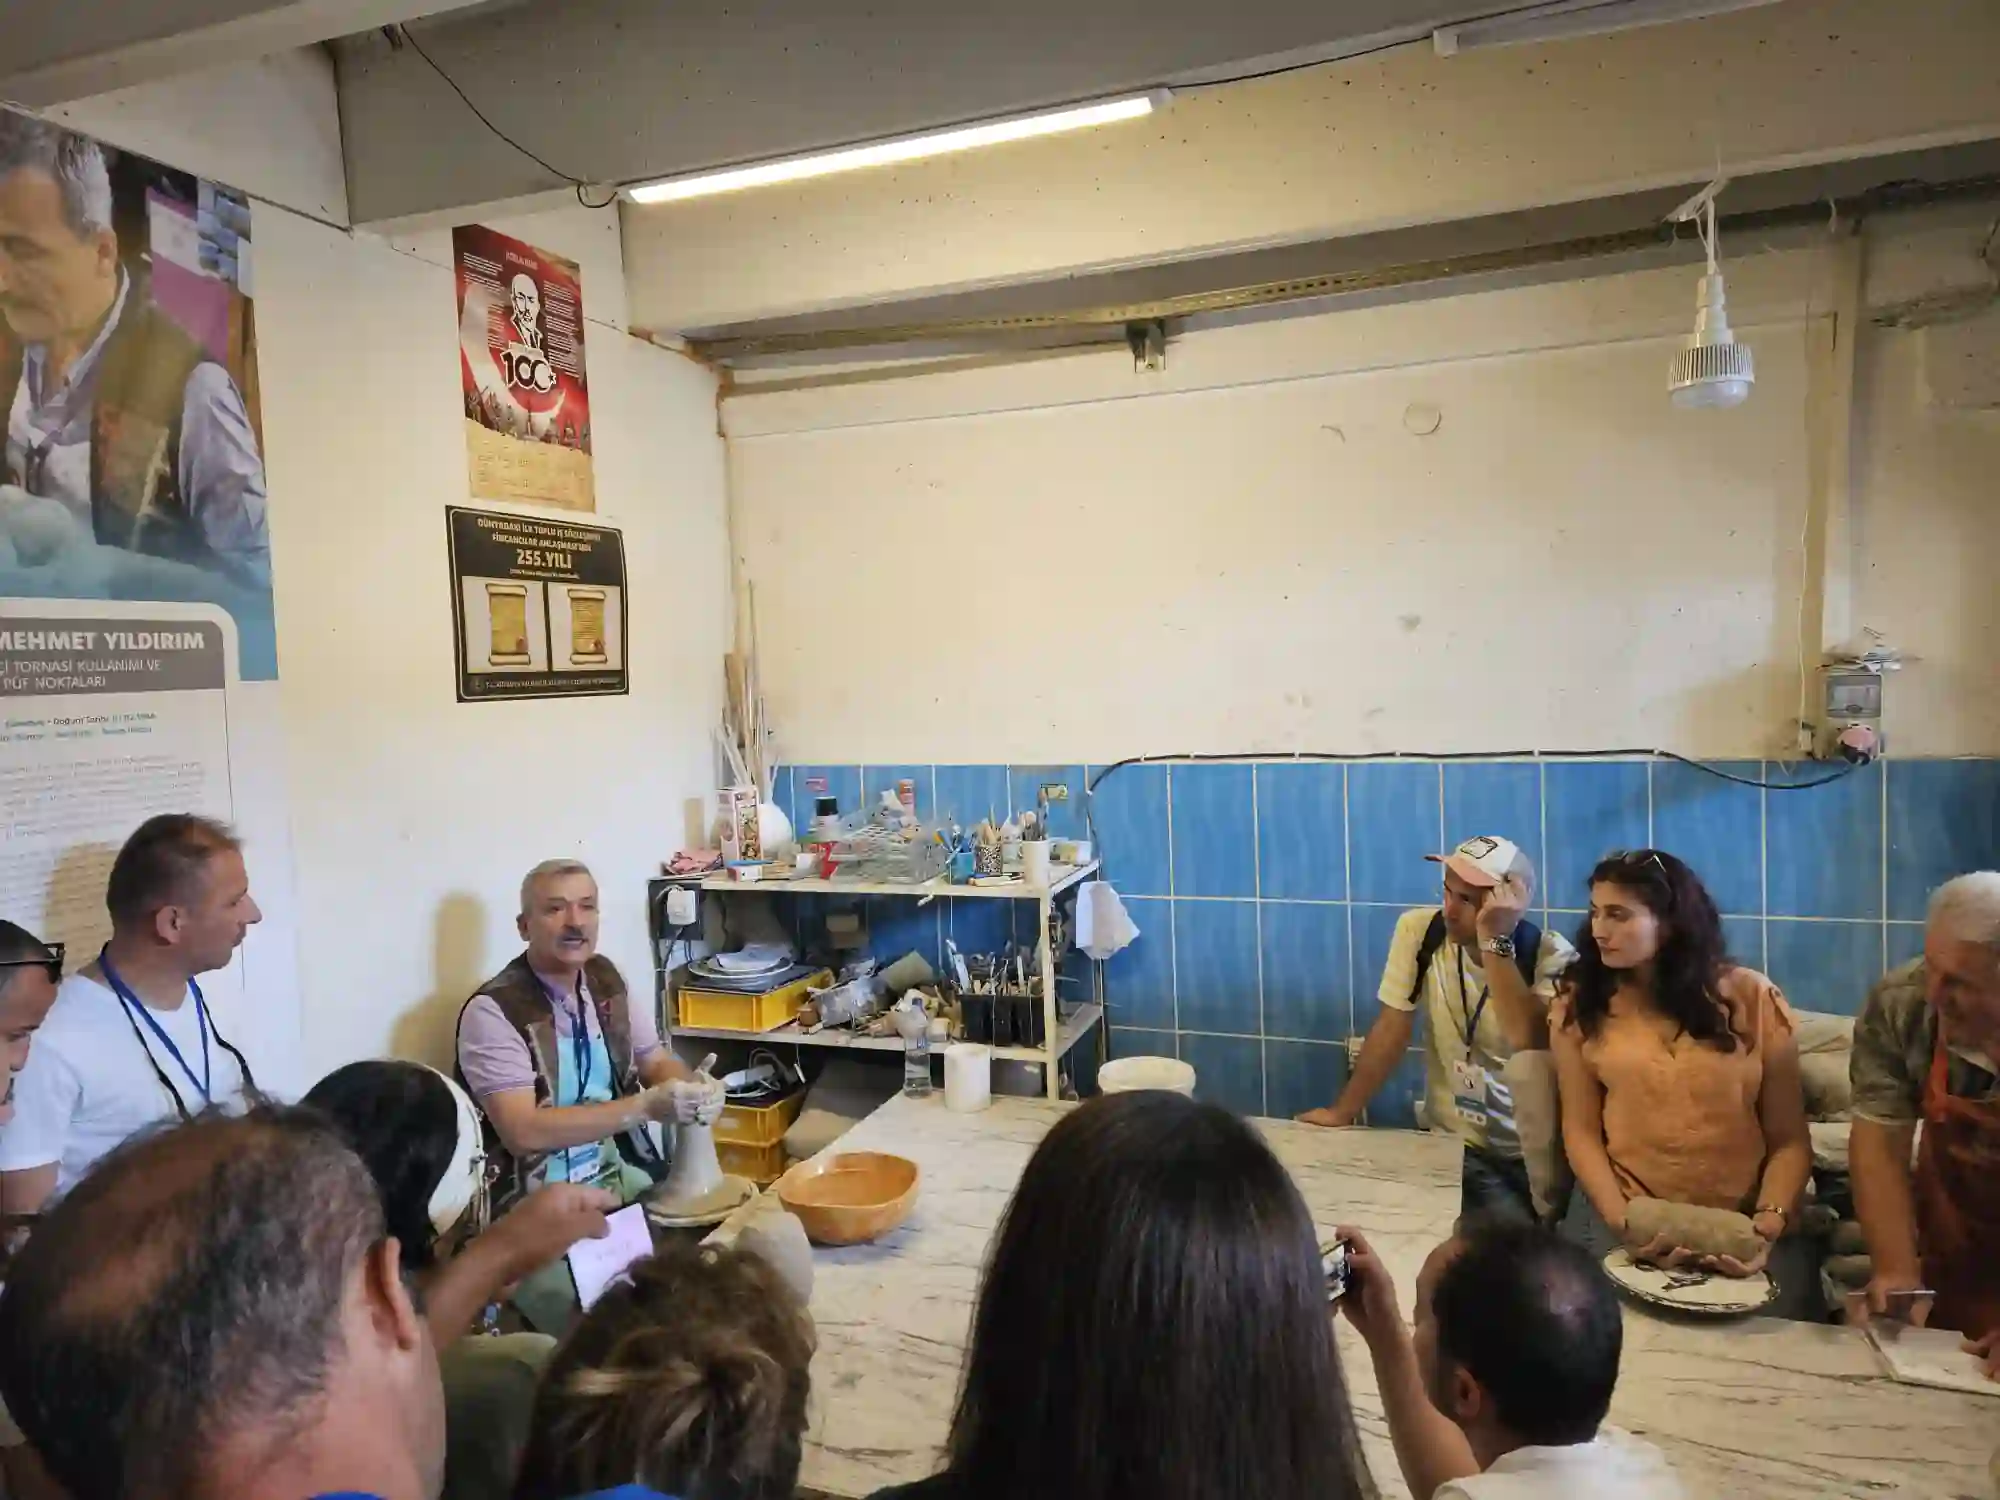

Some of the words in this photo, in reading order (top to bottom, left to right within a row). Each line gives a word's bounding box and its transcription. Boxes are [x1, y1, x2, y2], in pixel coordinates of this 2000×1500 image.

[501, 352, 552, 392] 100
[0, 631, 96, 650] MEHMET
[104, 632, 205, 650] YILDIRIM
[77, 659, 143, 673] KULLANIMI
[148, 659, 162, 672] VE
[3, 675, 29, 691] PÜF
[35, 675, 106, 691] NOKTALARI
